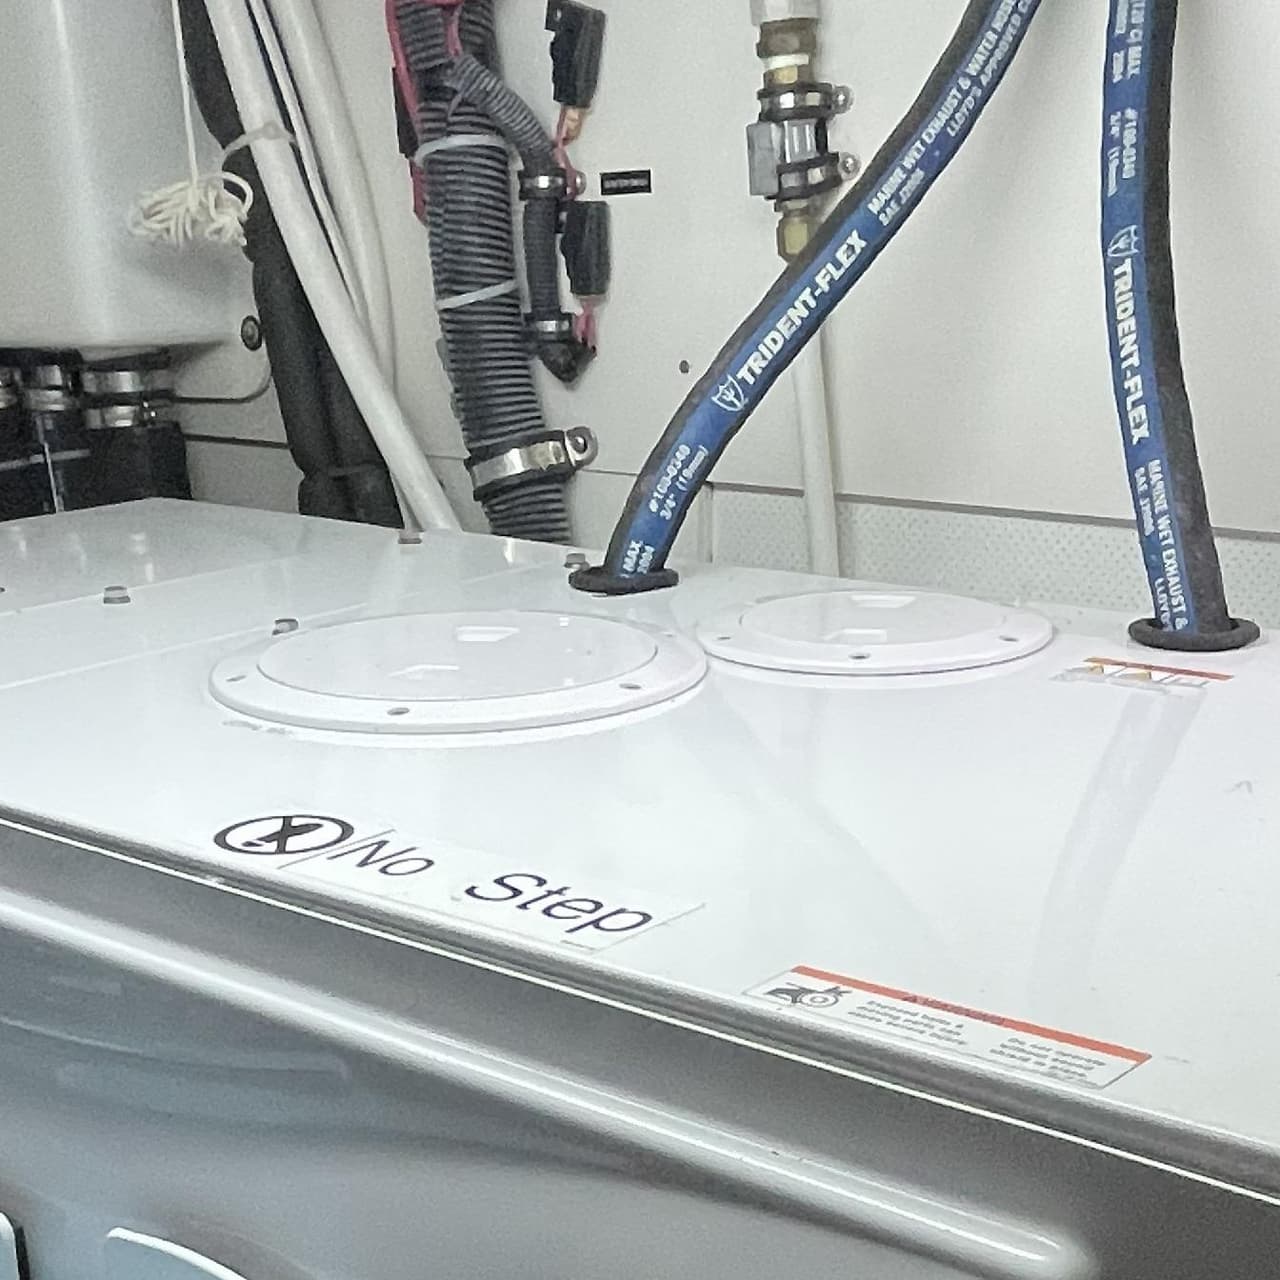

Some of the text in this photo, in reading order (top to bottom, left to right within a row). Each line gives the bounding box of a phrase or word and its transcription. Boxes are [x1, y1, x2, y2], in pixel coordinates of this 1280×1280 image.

[921, 88, 962, 146] EXHAUST
[736, 229, 868, 386] TRIDENT-FLEX
[1113, 258, 1150, 446] TRIDENT-FLEX
[1148, 459, 1169, 516] MARINE
[1157, 518, 1175, 547] WET
[1161, 547, 1188, 614] EXHAUST
[326, 838, 655, 934] No Step
